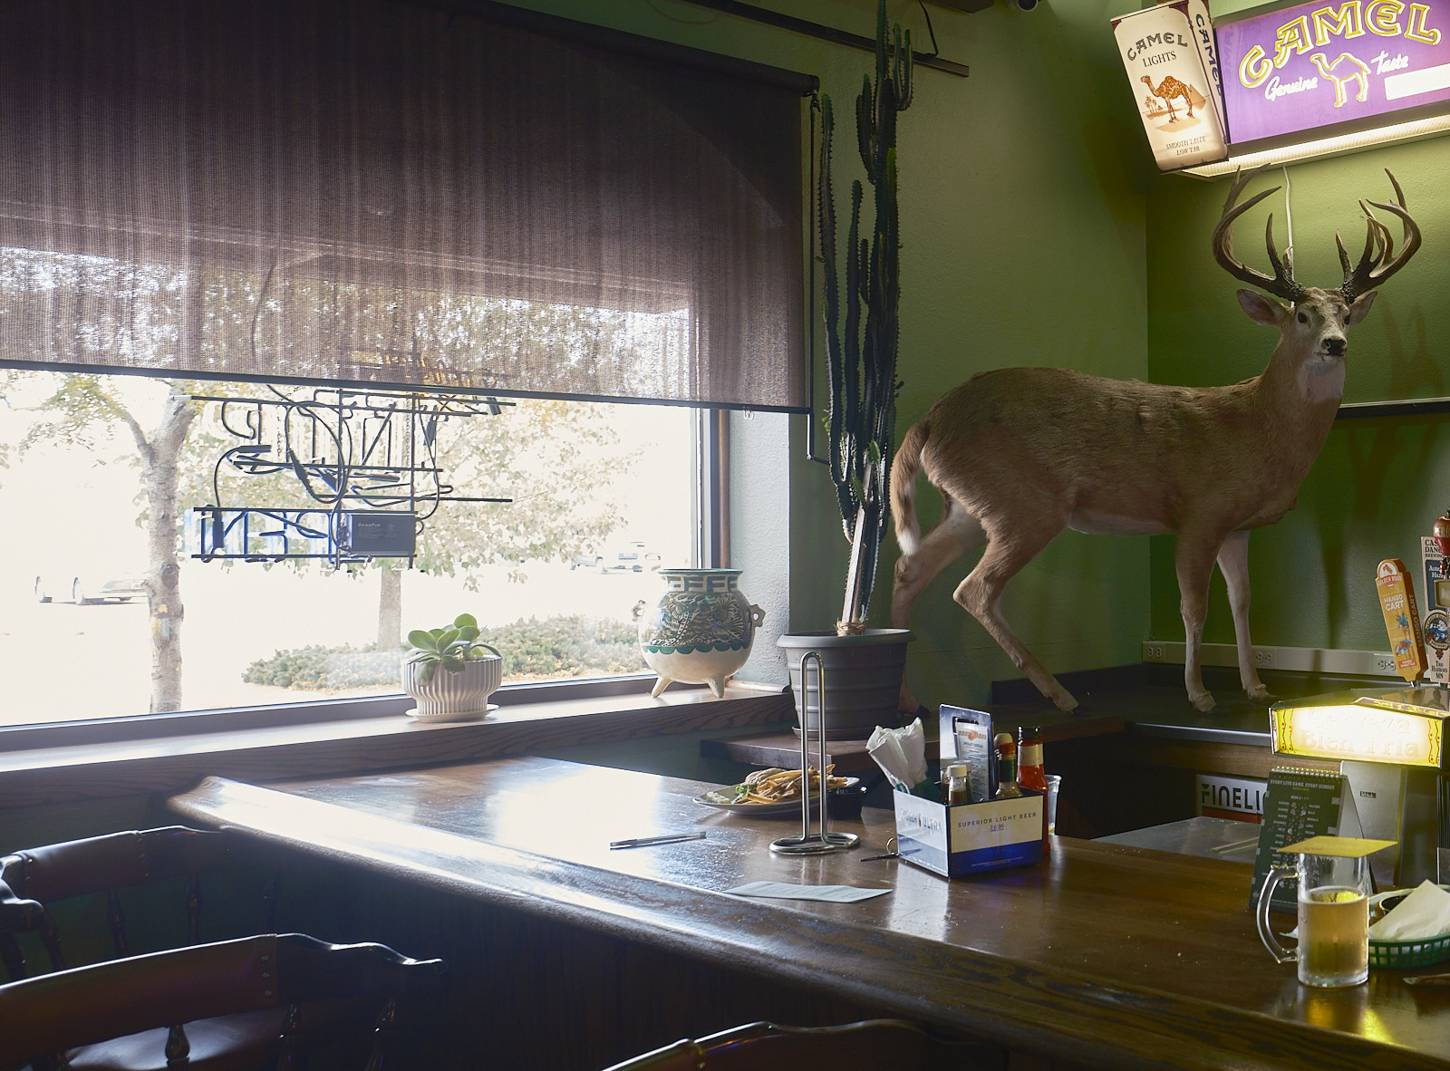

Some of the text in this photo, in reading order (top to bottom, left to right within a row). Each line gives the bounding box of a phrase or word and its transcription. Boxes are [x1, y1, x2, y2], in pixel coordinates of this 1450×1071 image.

[1127, 32, 1189, 61] CAMEL
[1142, 50, 1177, 67] LIGHTS
[1195, 13, 1223, 97] CAMEL
[1238, 0, 1442, 89] CAMEL
[1264, 50, 1409, 102] Genuine Taste
[958, 818, 993, 828] SUPERIOR
[995, 815, 1016, 823] LIGHT
[1019, 812, 1036, 820] BEER
